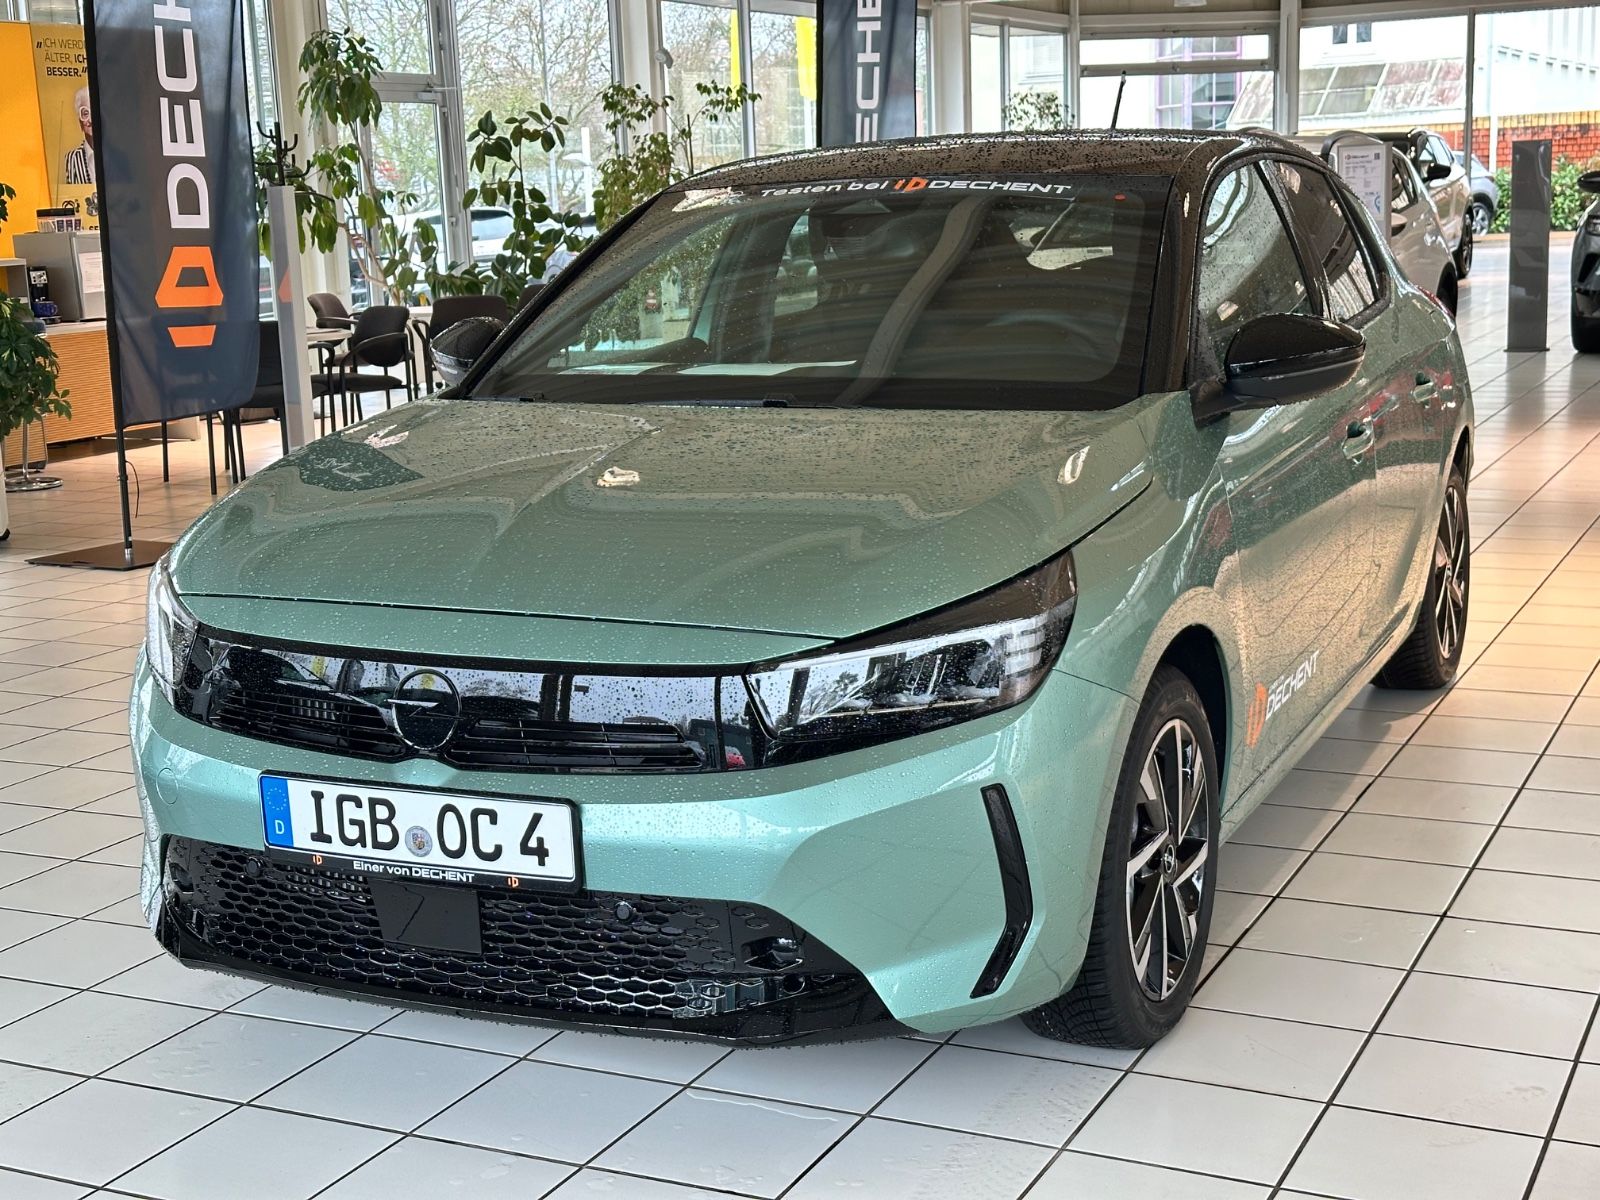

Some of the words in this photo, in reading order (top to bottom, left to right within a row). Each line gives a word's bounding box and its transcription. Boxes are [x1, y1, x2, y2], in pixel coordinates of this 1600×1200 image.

[761, 184, 842, 197] Testen
[847, 180, 889, 191] bei
[928, 180, 1072, 194] DECHENT
[1265, 649, 1320, 721] DECHENT
[274, 819, 285, 835] D
[310, 790, 400, 851] IGB
[436, 803, 503, 862] OC
[519, 812, 549, 867] 4
[353, 860, 385, 873] Einer
[386, 865, 410, 876] von
[412, 867, 475, 883] DECHENT
